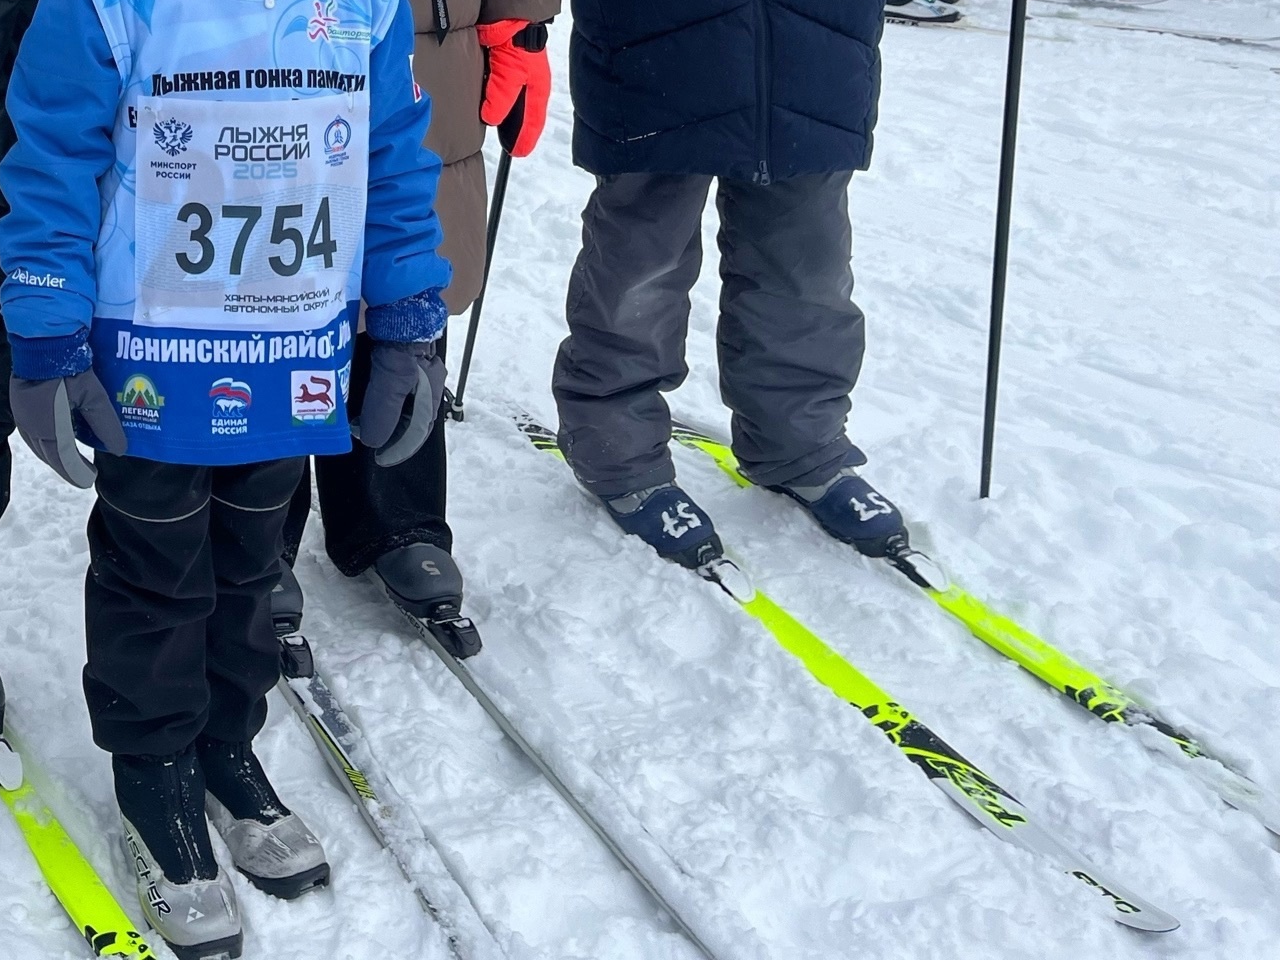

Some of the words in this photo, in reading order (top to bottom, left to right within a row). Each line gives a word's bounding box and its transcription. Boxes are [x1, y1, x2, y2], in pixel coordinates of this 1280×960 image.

[245, 68, 303, 90] гонка
[218, 123, 308, 143] ЛЫЖНЯ
[214, 141, 310, 162] РОССИИ
[150, 161, 197, 171] МИНСПОРТ
[232, 161, 298, 180] 2025
[156, 171, 191, 180] РОССИИ
[175, 195, 337, 277] 3754
[224, 287, 330, 304] ХАНТЫ-МАНСИЙСКИЙ
[224, 303, 299, 314] АВТОНОМНЫЙ
[303, 299, 329, 312] ОКРУГ
[116, 330, 266, 364] Ленинский
[269, 329, 334, 364] райо
[121, 406, 159, 418] ЛЕГЕНДА
[211, 418, 248, 427] ЕДИНАЯ
[211, 426, 248, 435] РОССИЯ
